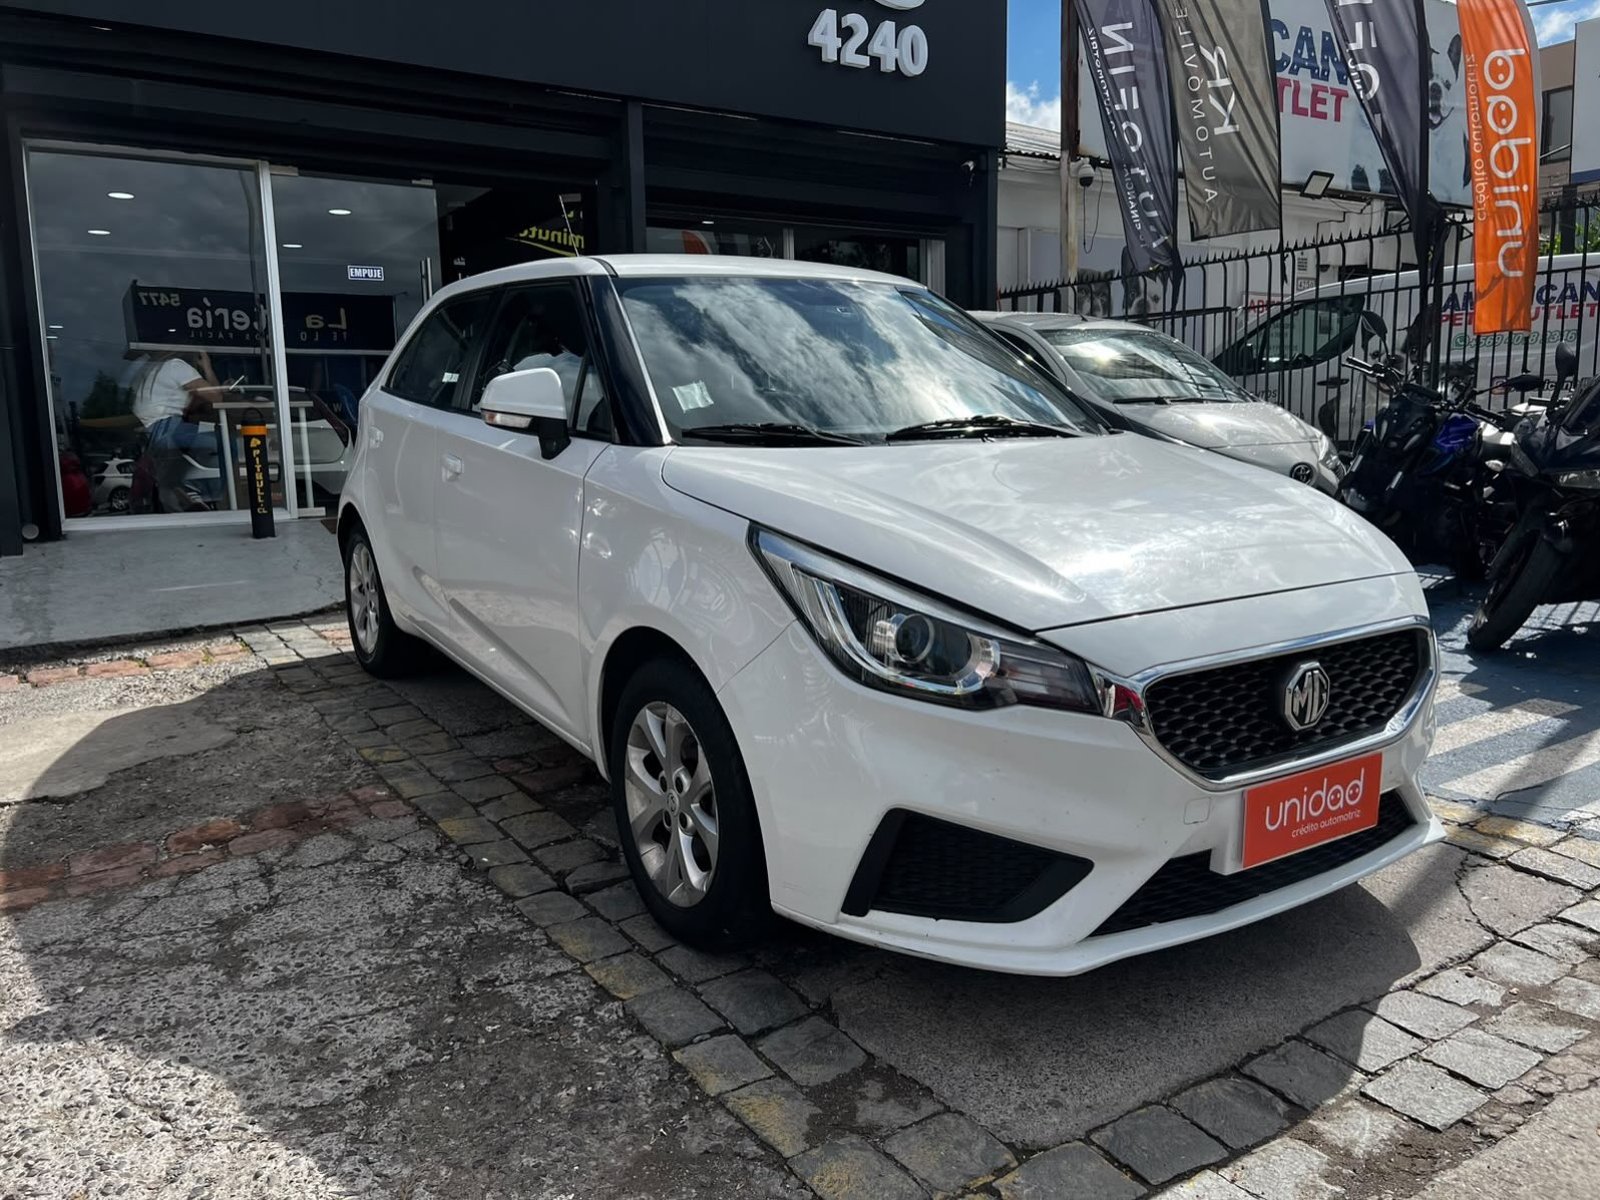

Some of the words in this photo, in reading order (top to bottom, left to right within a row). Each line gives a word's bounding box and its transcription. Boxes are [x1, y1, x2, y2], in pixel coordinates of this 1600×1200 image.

[807, 8, 929, 77] 4240
[350, 268, 382, 278] EMPUJE
[1291, 667, 1329, 726] MG
[1265, 767, 1365, 832] unidad
[1291, 820, 1319, 838] crédito
[1319, 808, 1362, 830] automotriz
